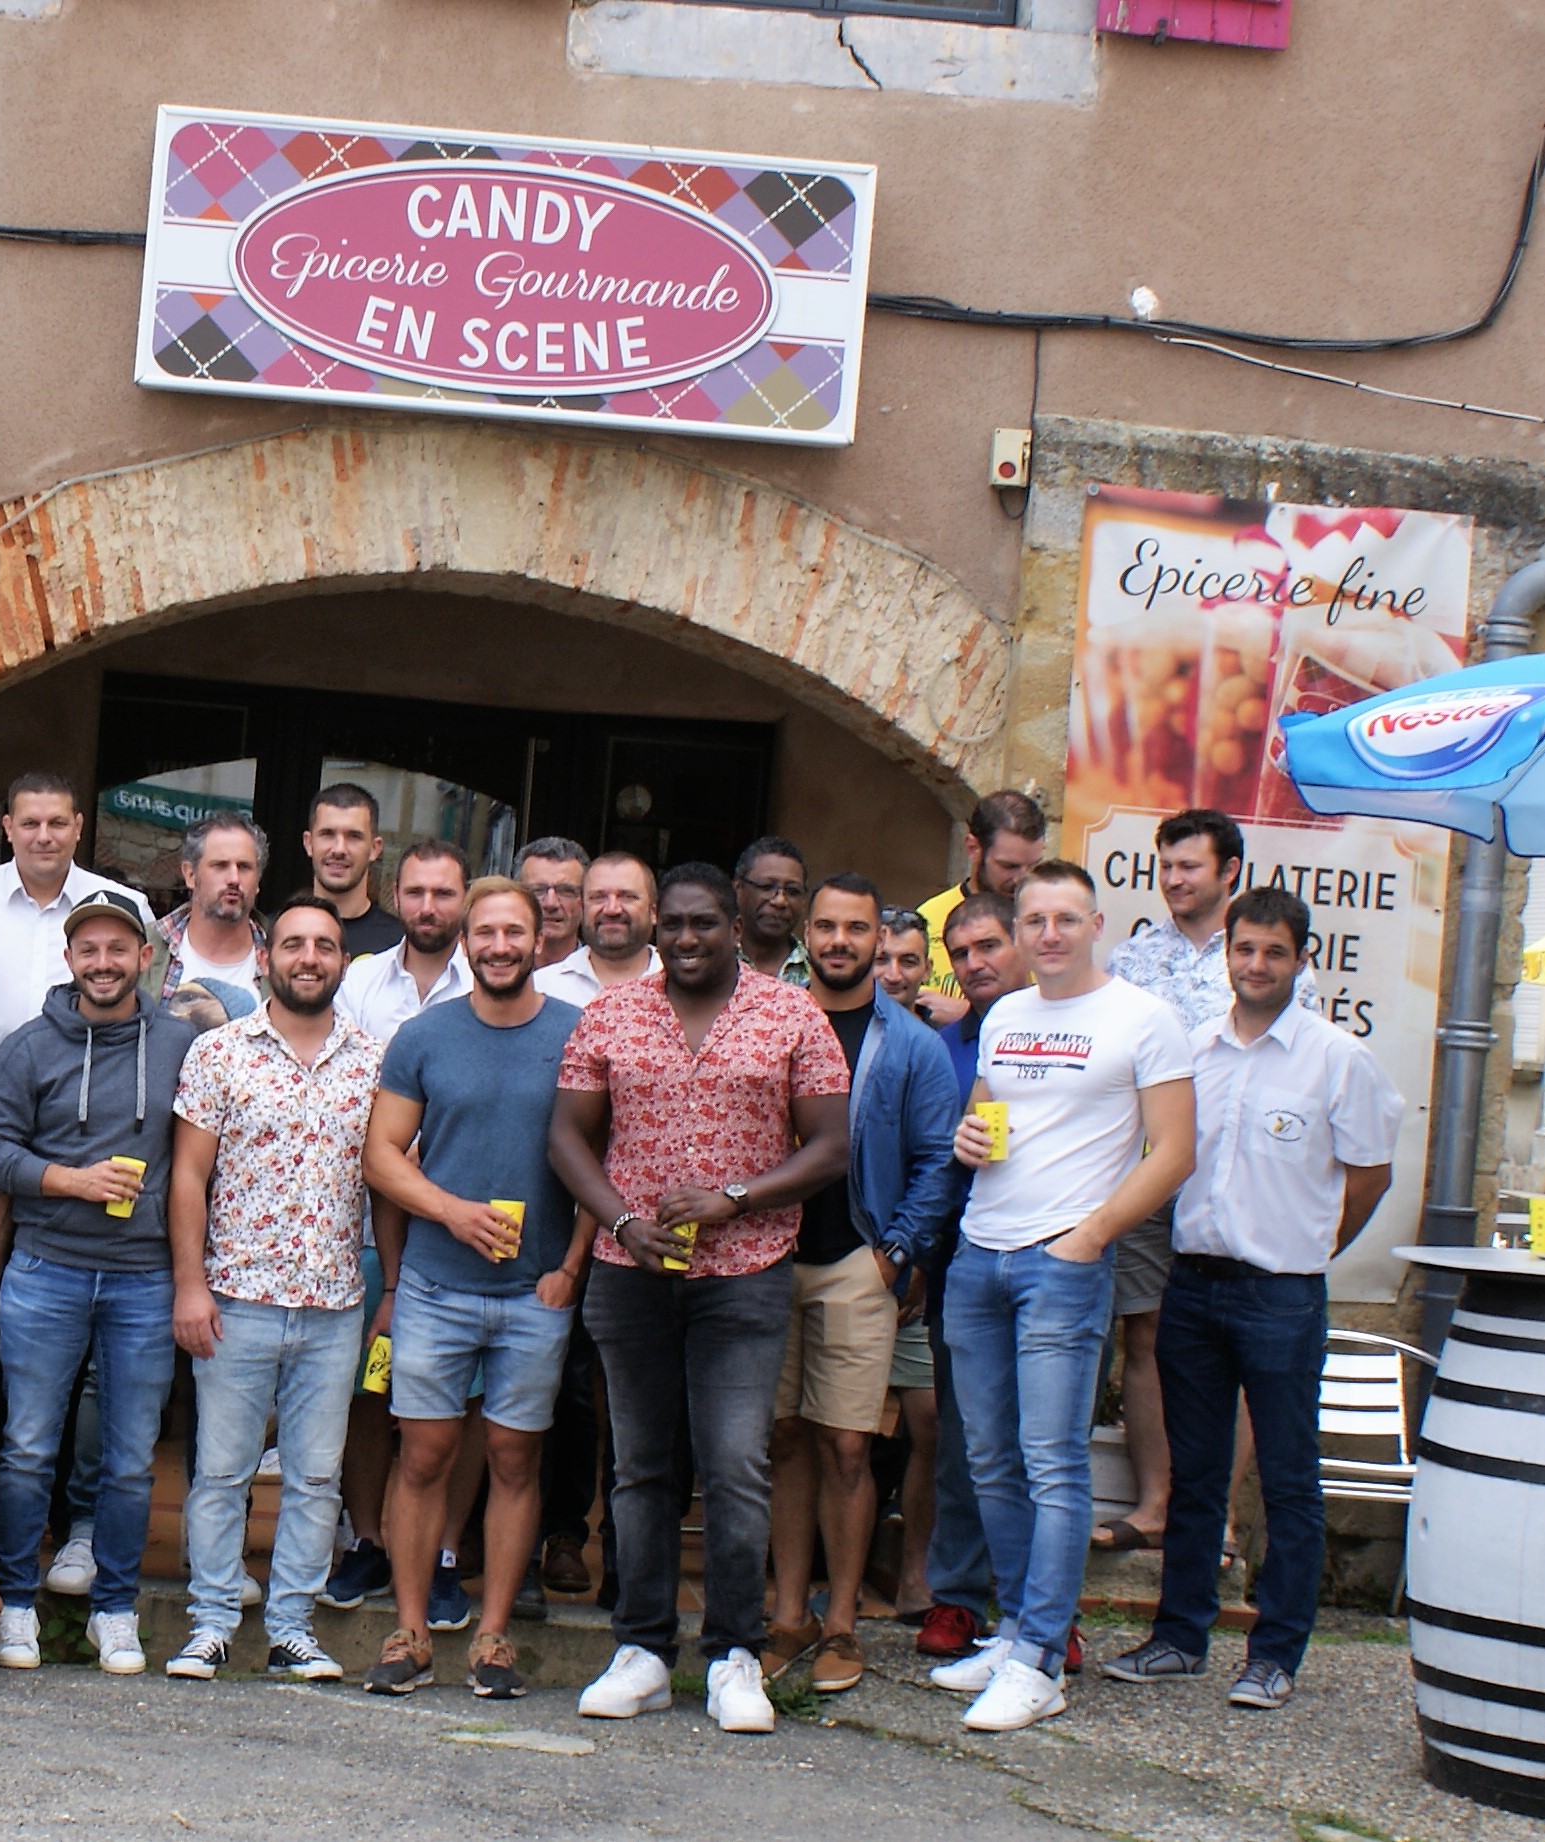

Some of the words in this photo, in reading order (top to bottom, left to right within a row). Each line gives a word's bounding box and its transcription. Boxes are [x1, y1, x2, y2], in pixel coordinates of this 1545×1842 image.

[407, 184, 616, 253] CANDY
[270, 232, 449, 299] Epicerie
[475, 250, 742, 313] Gourmande
[355, 295, 436, 360] EN
[458, 315, 651, 373] SCENE
[1119, 537, 1317, 610] Epicerie
[1326, 555, 1429, 626] fine
[1104, 850, 1397, 911] CHLATERIE
